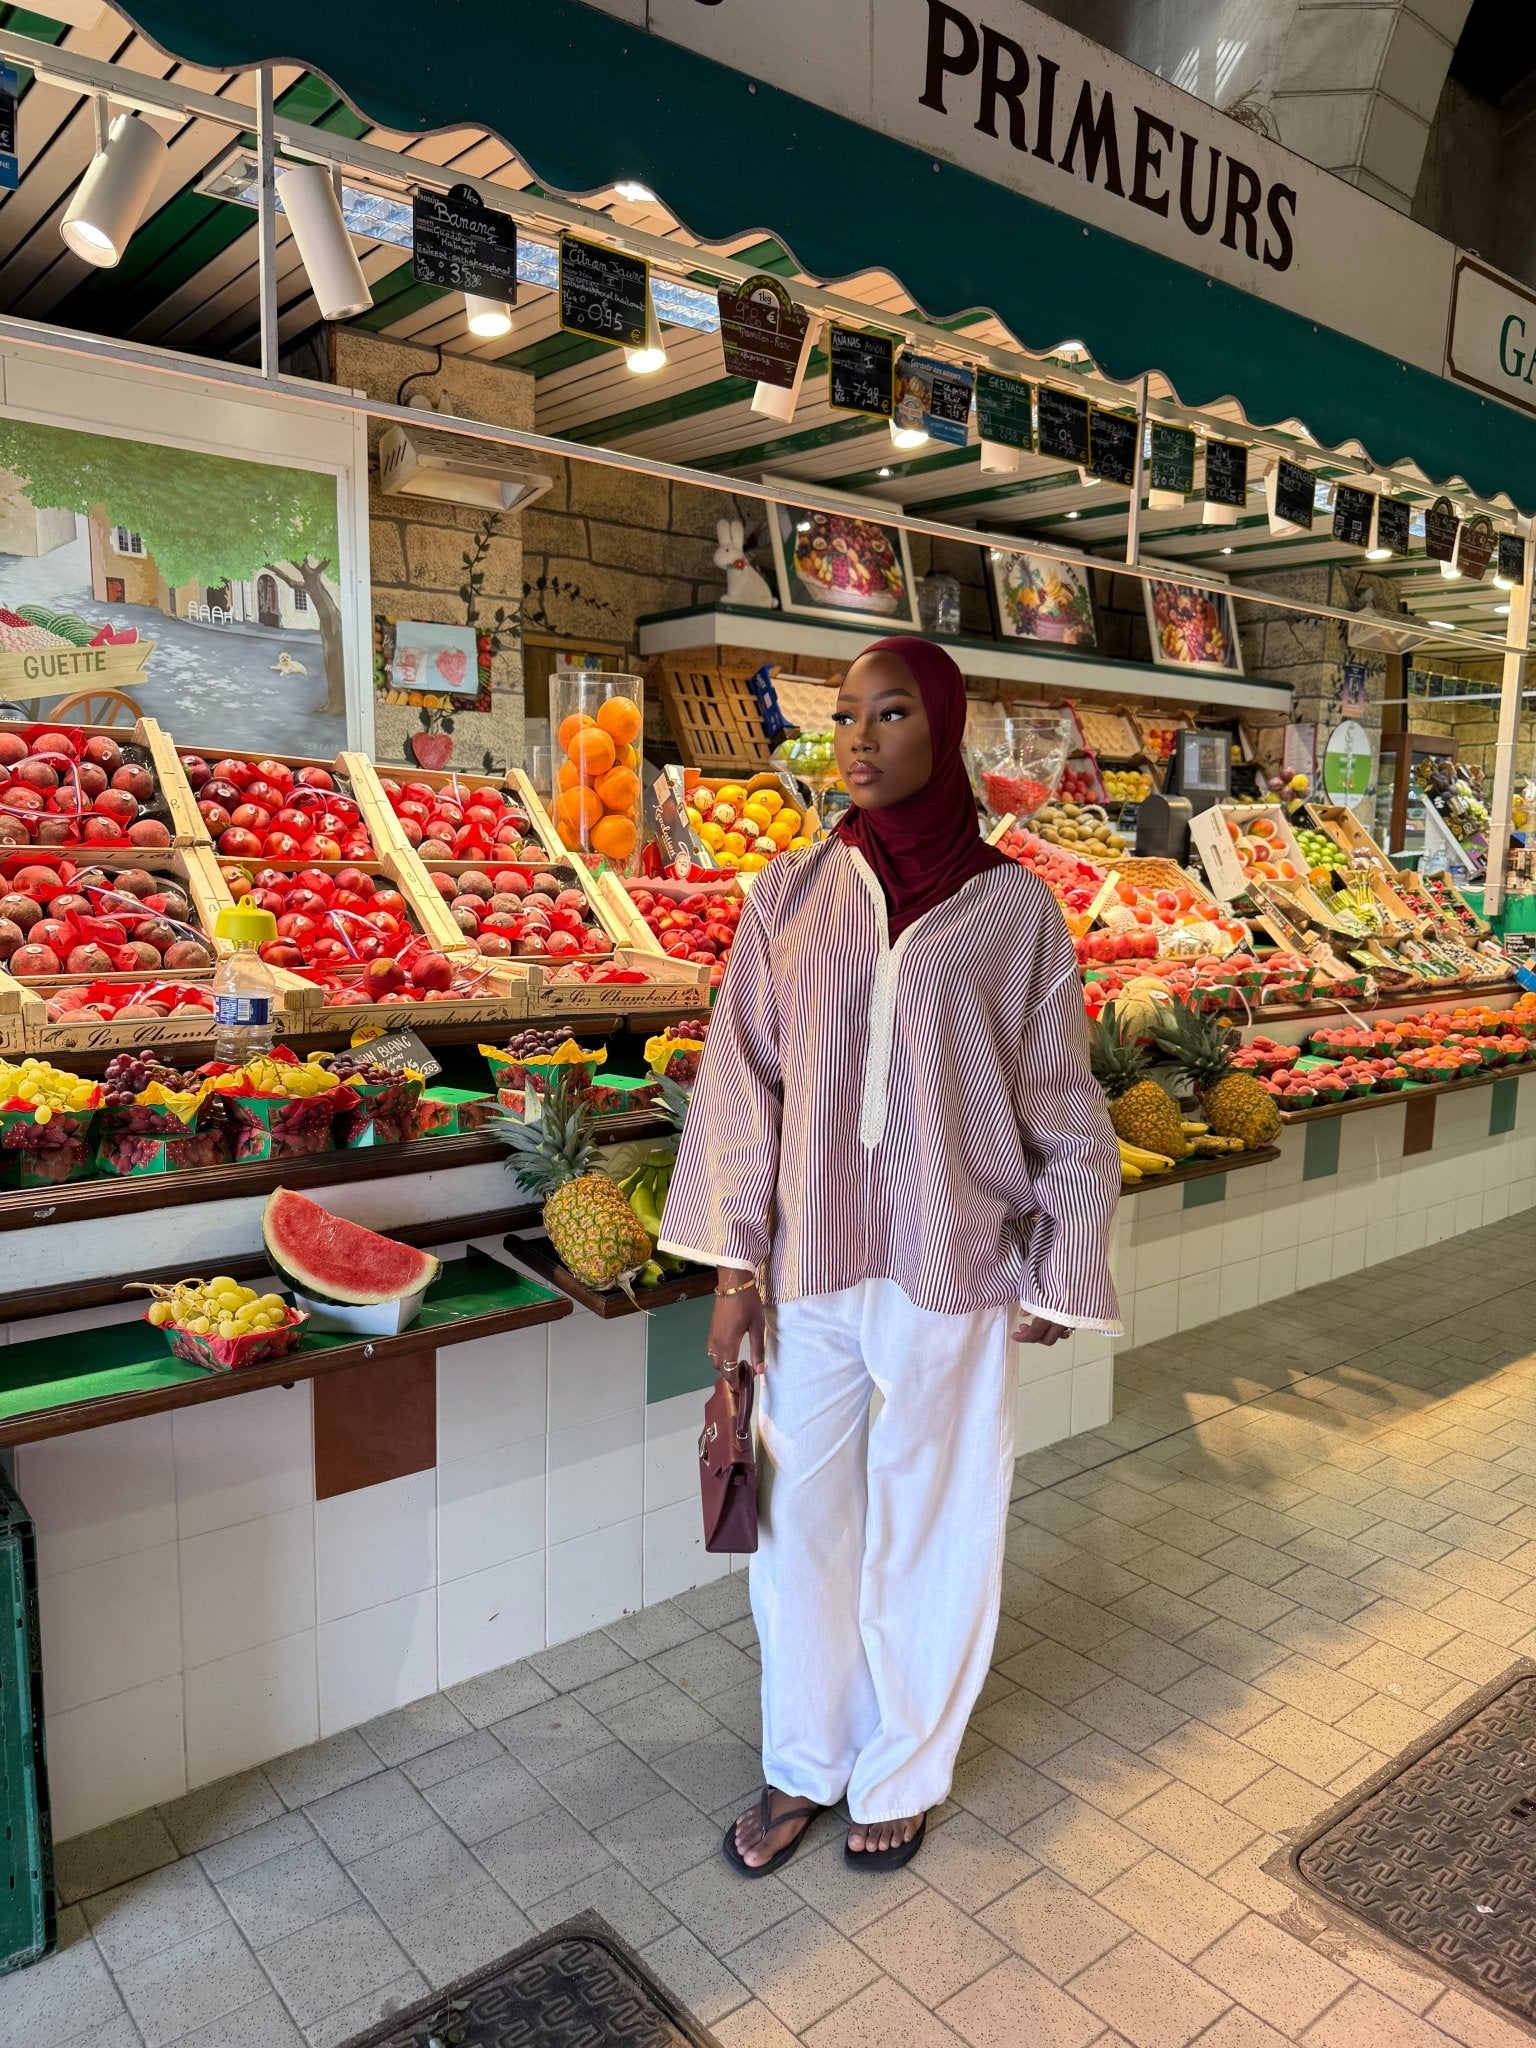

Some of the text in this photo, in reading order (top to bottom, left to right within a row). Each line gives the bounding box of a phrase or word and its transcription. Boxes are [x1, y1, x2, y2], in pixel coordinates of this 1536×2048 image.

[918, 0, 1297, 272] PRIMEURS
[759, 292, 772, 305] 1kg
[767, 311, 777, 324] €
[832, 334, 861, 349] ANANAS
[988, 376, 1026, 397] GRENADE
[23, 650, 107, 680] GUETTE
[376, 1035, 412, 1058] BLANC
